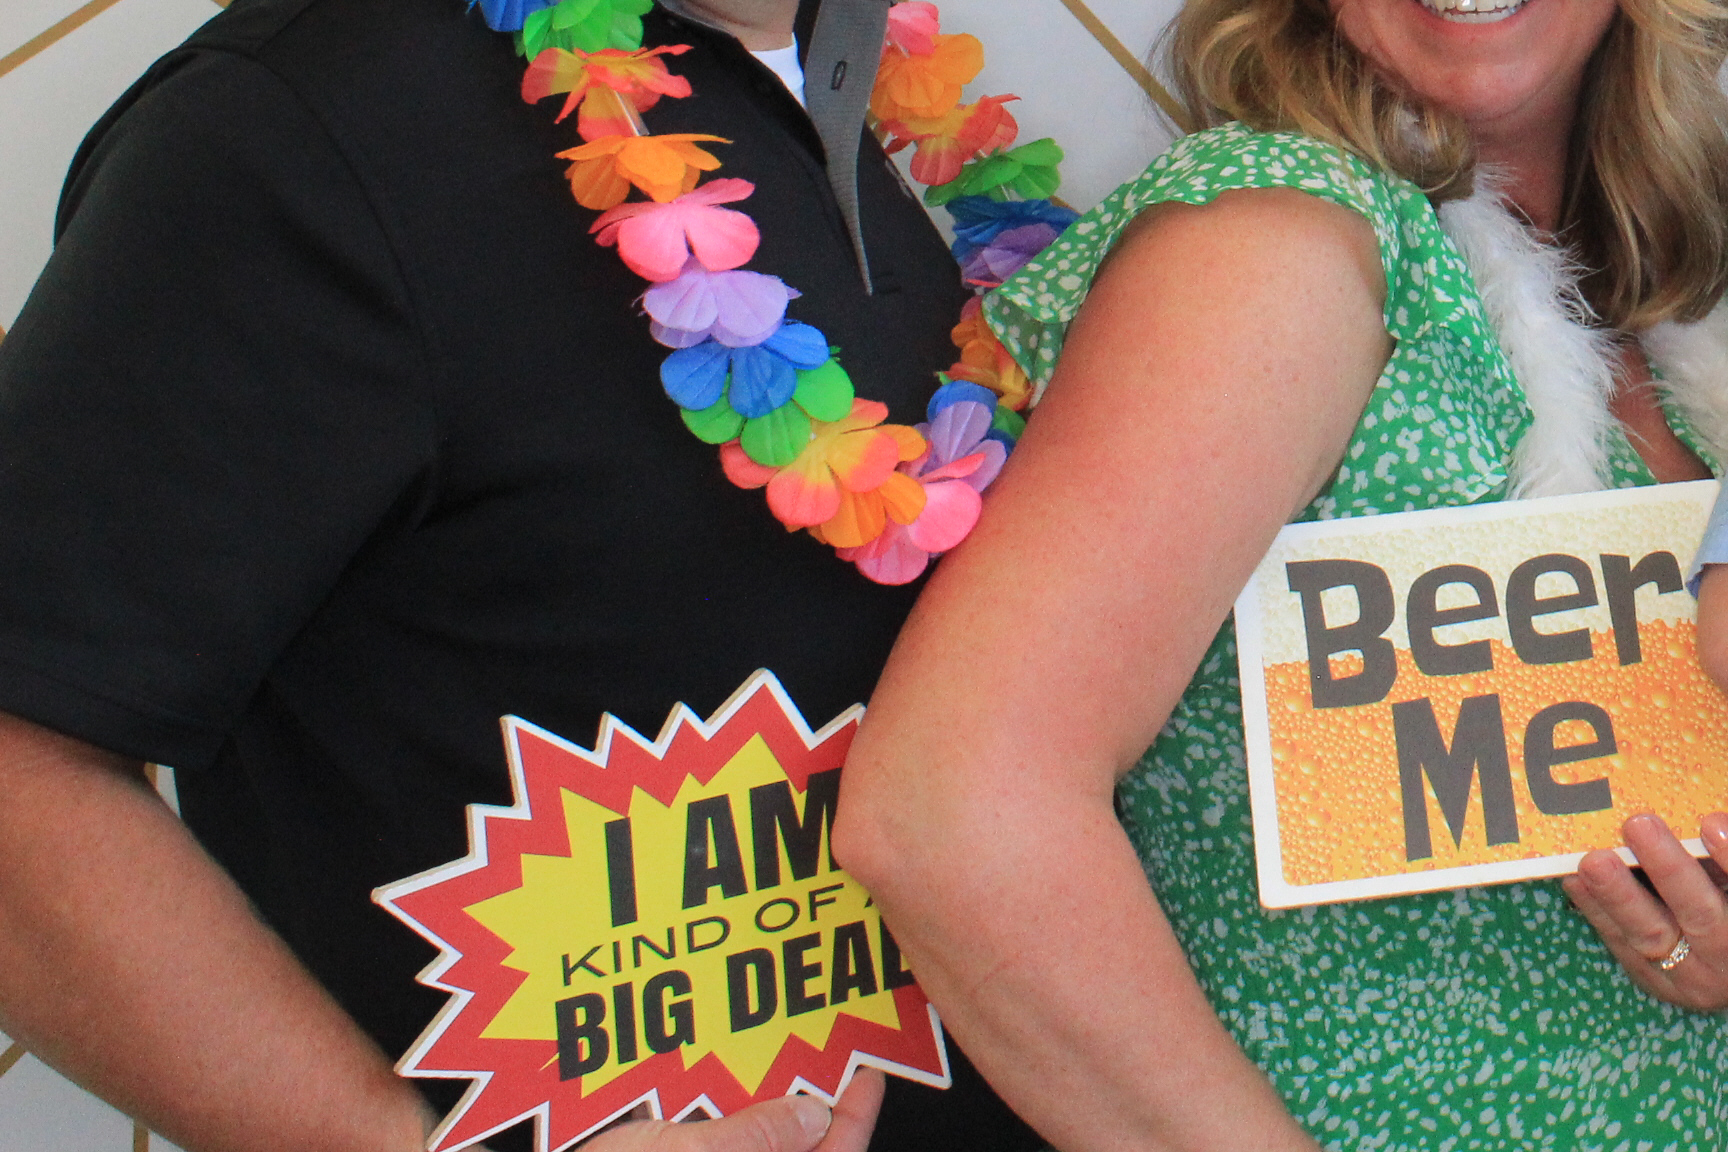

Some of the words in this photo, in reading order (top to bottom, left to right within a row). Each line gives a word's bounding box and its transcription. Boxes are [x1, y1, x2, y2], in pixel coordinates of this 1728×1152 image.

[1284, 550, 1684, 709] Beer
[604, 816, 639, 928] I
[681, 767, 843, 910] AM
[1391, 693, 1619, 862] Me
[554, 968, 697, 1083] BIG
[725, 915, 916, 1033] DEAL
[561, 916, 731, 986] KIND
[754, 883, 845, 932] OF
